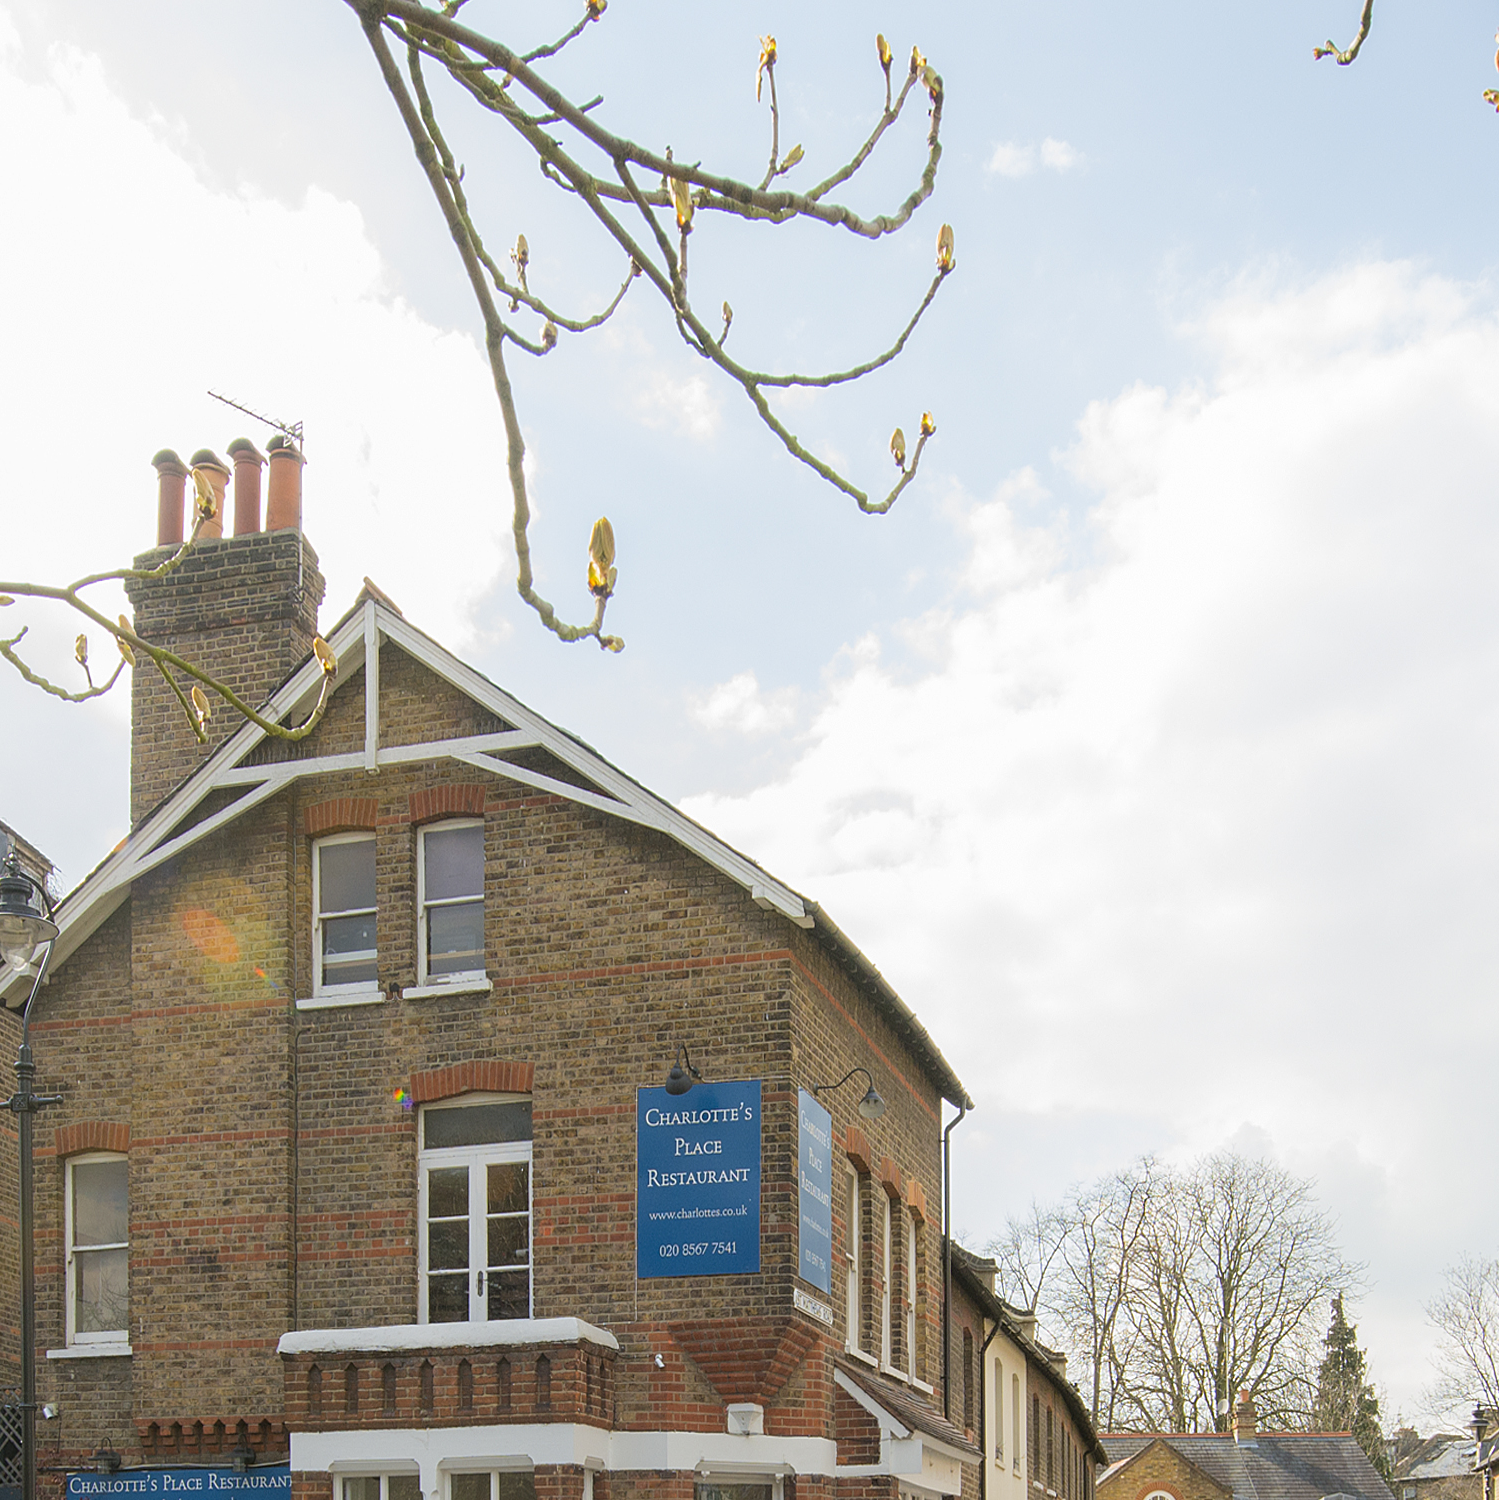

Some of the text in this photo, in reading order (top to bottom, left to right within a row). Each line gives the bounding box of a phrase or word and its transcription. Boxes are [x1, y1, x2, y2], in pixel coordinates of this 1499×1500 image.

[646, 1102, 752, 1127] CHARLOTTE'S
[674, 1138, 722, 1156] PLACE
[808, 1147, 823, 1173] PLACE
[647, 1168, 750, 1188] RESTAURANT
[648, 1205, 748, 1221] www.charlottes.co.uk
[659, 1242, 737, 1257] 020 8567 7541
[70, 1474, 292, 1494] CHARLOTTE'S PLACE RESTAURANT
